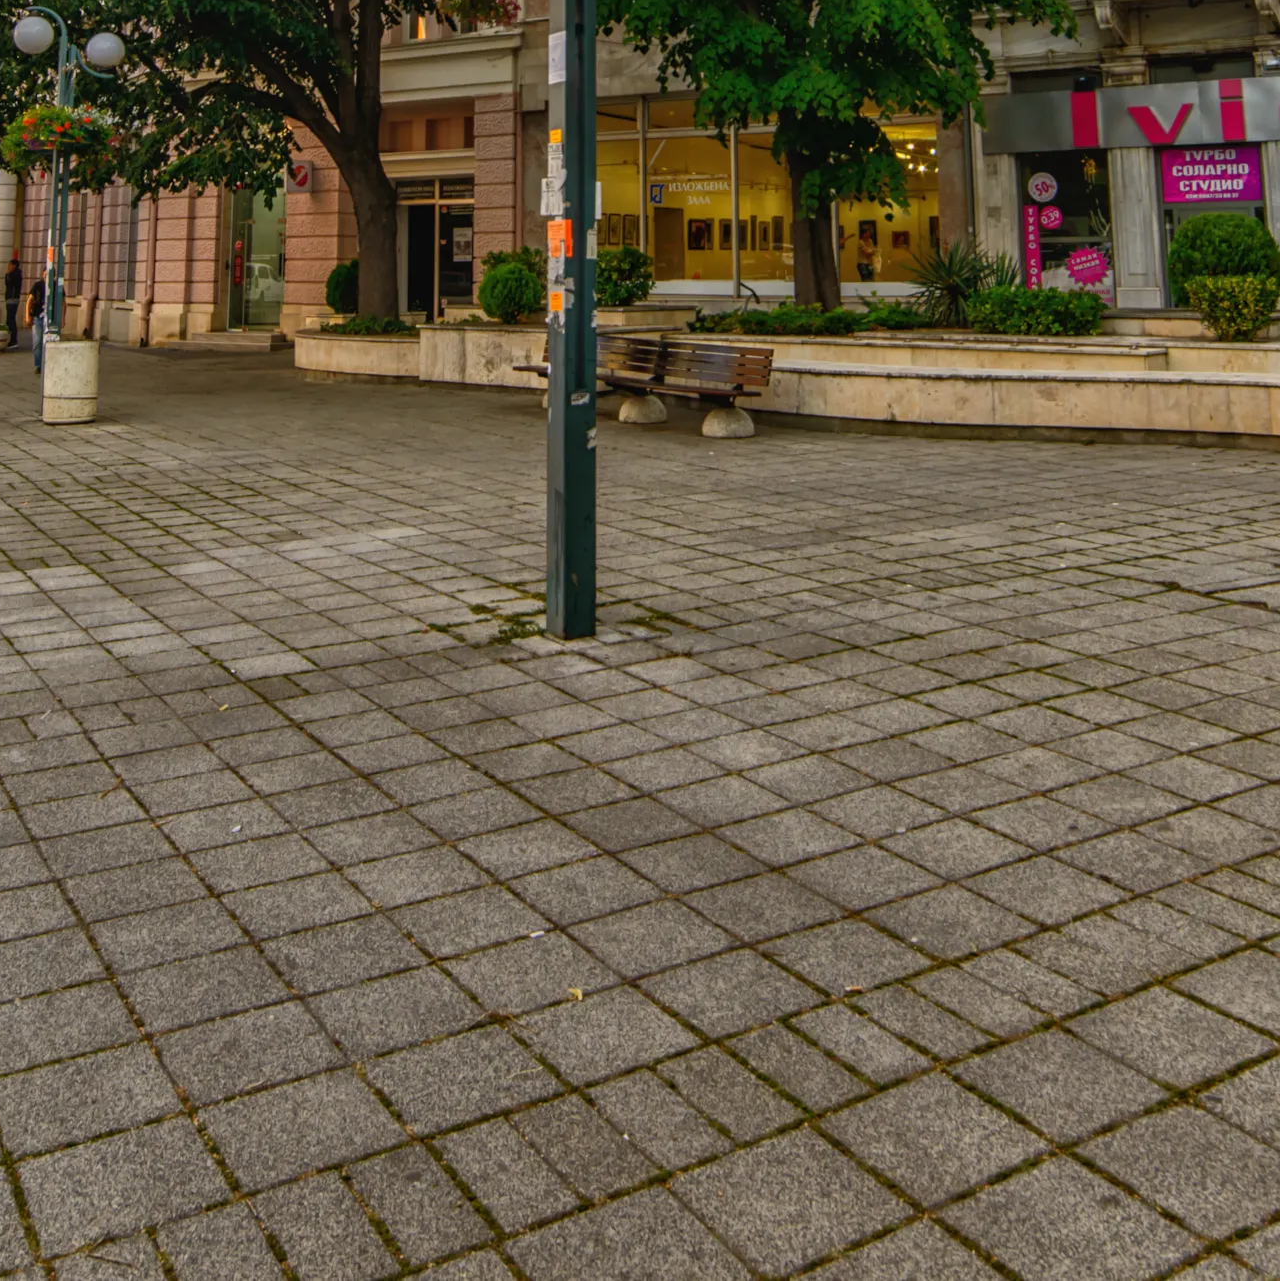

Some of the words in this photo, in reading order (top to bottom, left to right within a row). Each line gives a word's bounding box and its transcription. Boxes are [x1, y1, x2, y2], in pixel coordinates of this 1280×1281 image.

[1183, 149, 1236, 161] ТУРБО
[1172, 163, 1249, 176] СОЛАРНО
[669, 182, 729, 191] ИЗЛОЖБЕНА
[1179, 179, 1244, 192] СТУДИО
[687, 196, 711, 205] ЗАЛА
[1028, 208, 1037, 249] ТУРБО
